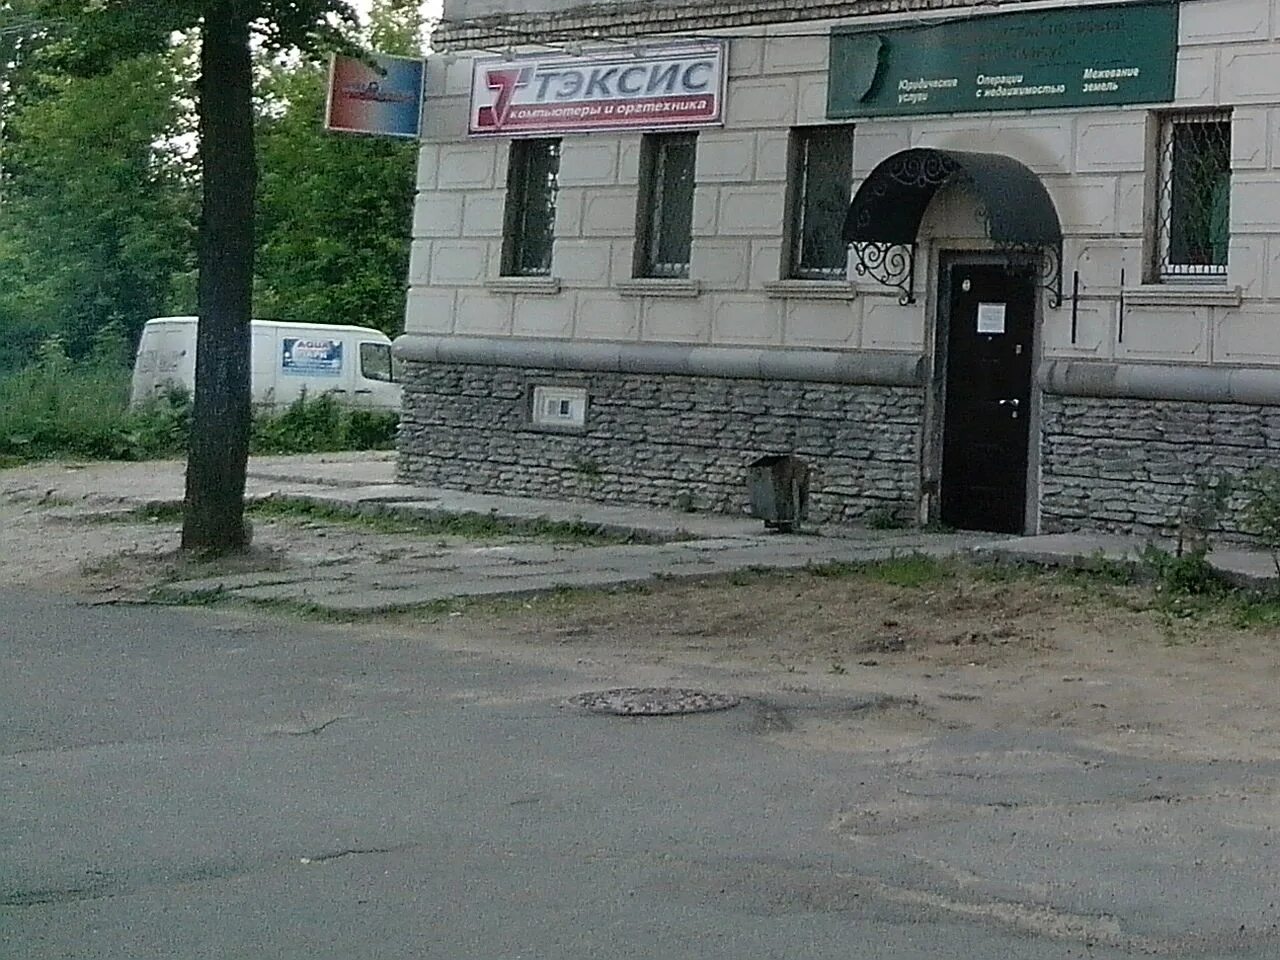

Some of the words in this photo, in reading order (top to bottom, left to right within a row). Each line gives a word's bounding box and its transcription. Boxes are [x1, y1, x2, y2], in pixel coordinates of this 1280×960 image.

[976, 73, 1024, 86] Операции
[1082, 67, 1140, 80] Межевание
[535, 61, 713, 101] ТЭКСИС
[898, 77, 958, 91] Юридические
[1082, 81, 1119, 93] земель
[983, 84, 1066, 98] недвижимостью
[509, 105, 601, 121] компьютеры
[604, 106, 613, 114] и
[616, 99, 707, 114] оргтехника
